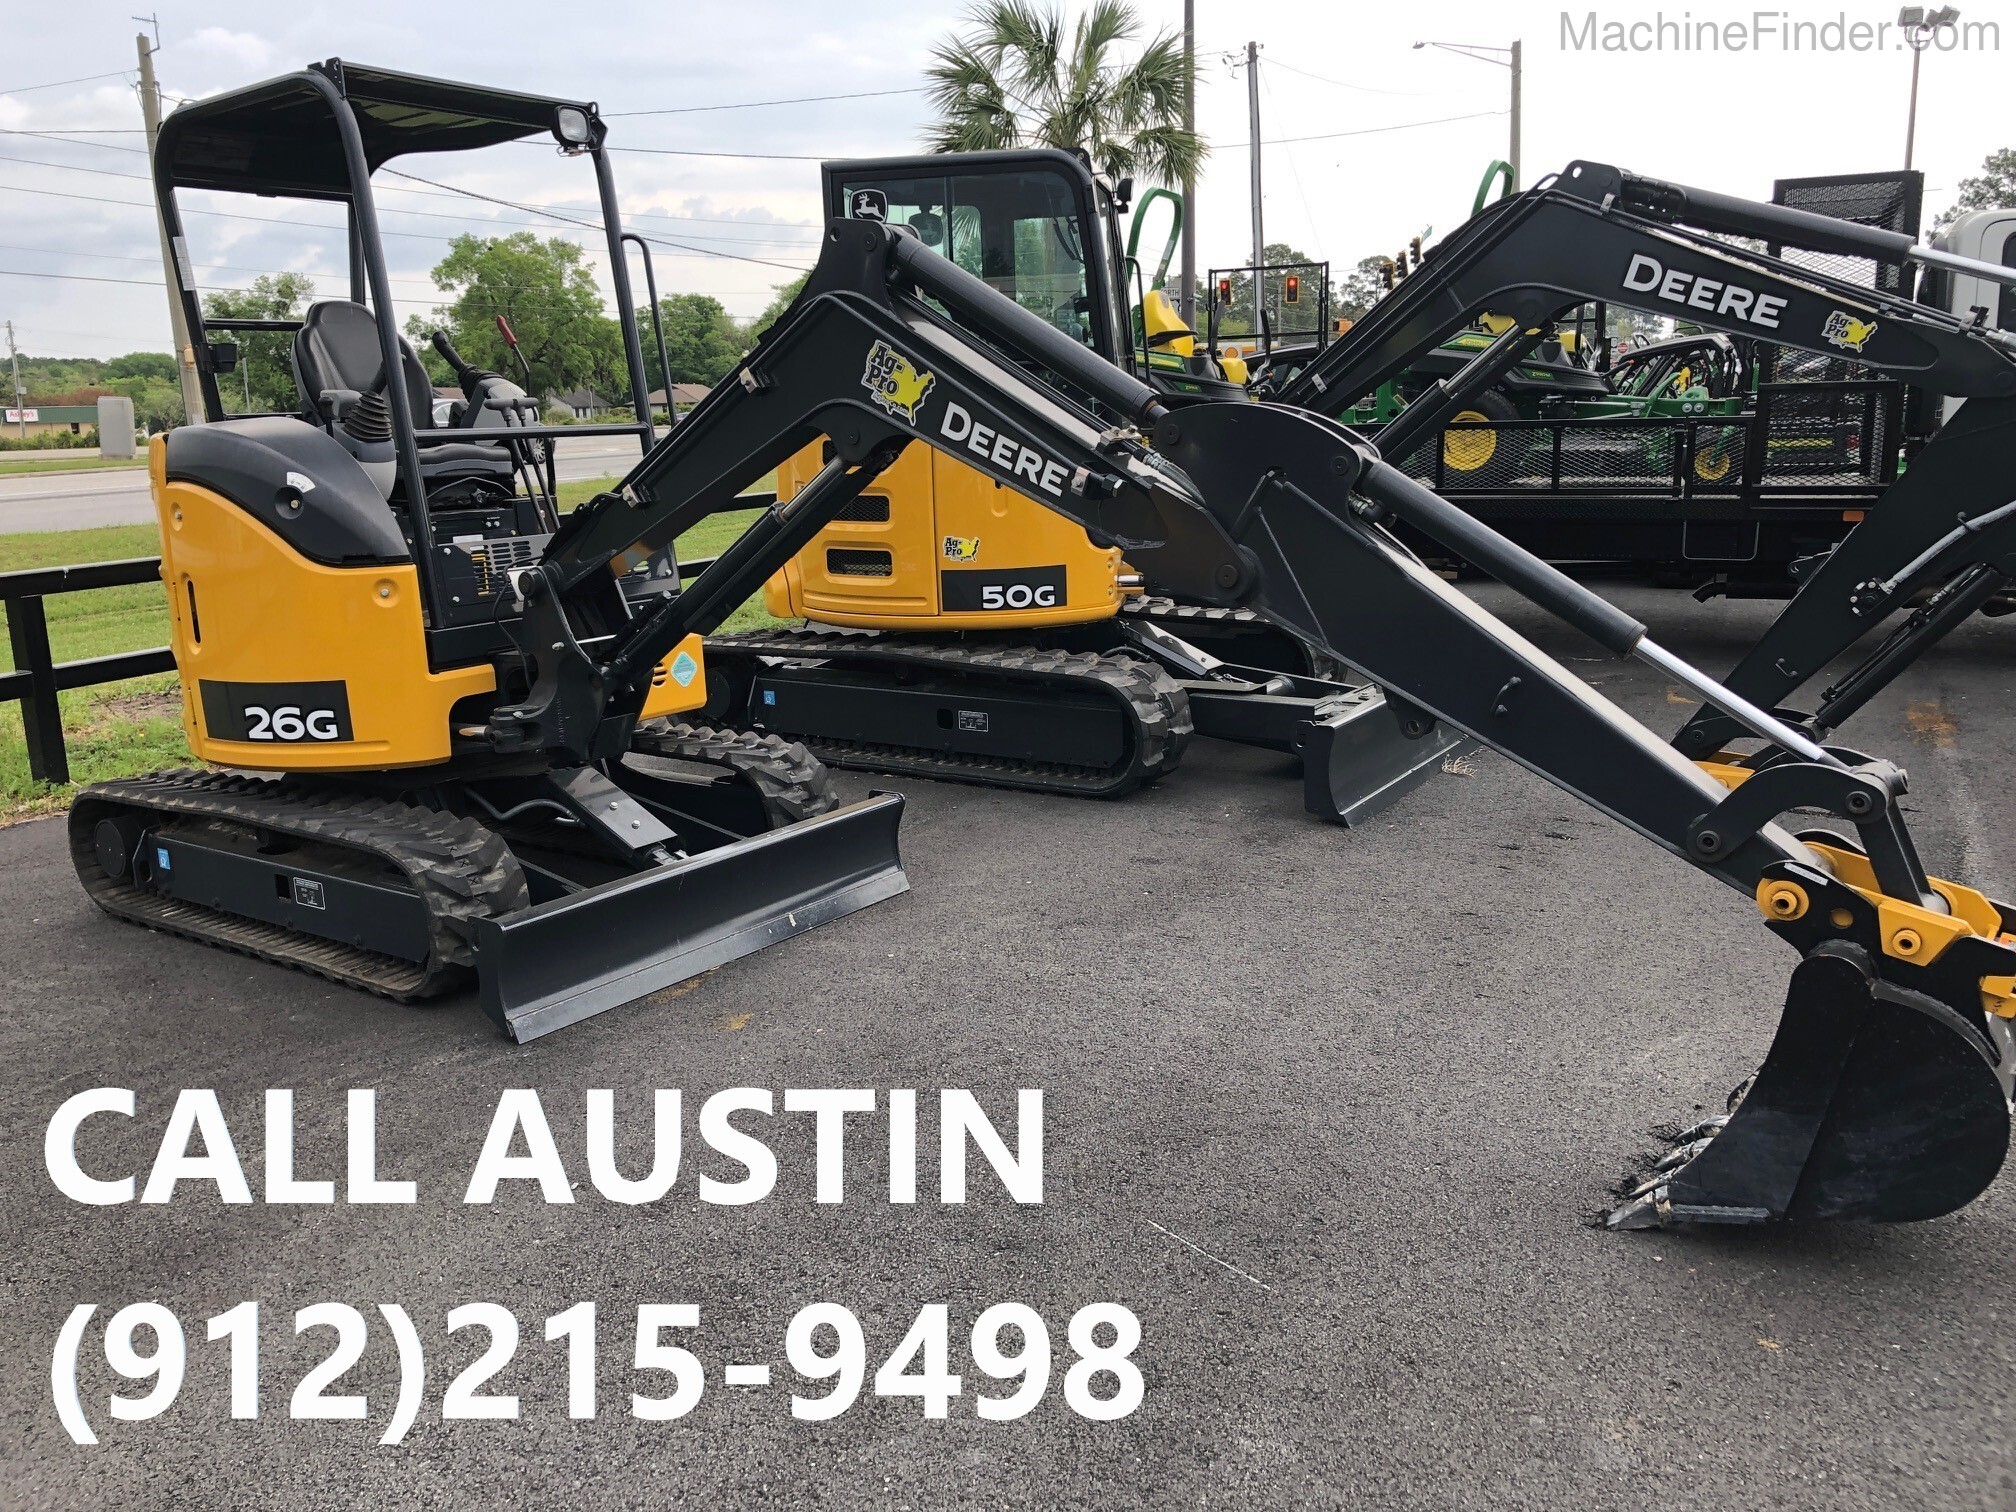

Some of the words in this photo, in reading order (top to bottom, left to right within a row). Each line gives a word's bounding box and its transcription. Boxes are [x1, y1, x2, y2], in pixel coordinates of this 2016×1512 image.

[1623, 254, 1788, 328] DEERE
[1825, 325, 1848, 338] Pro
[1830, 314, 1852, 328] Ag-
[870, 344, 903, 376] Ag-
[865, 364, 898, 394] Pro
[940, 401, 1069, 497] DEERE
[945, 538, 962, 548] Ag-
[945, 547, 962, 556] Pro
[982, 584, 1055, 609] 50G
[245, 706, 338, 740] 26G
